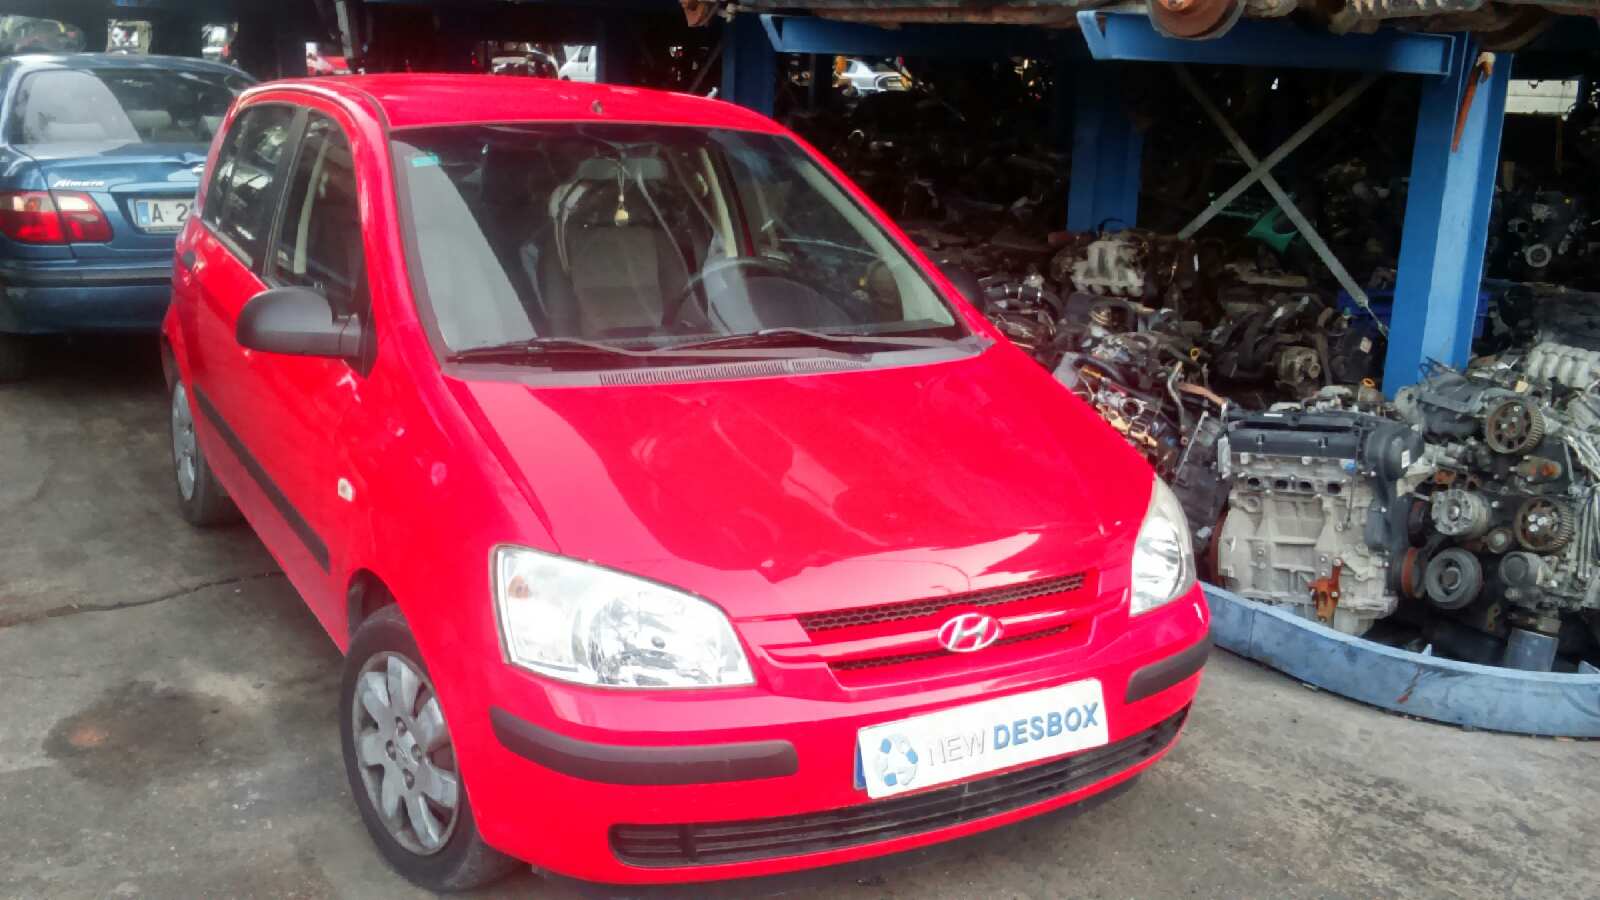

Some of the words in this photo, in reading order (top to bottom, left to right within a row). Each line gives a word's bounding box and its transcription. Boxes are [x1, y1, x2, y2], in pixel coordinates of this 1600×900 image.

[152, 203, 164, 223] A
[928, 729, 985, 766] NEW
[993, 702, 1098, 750] DESBOX
